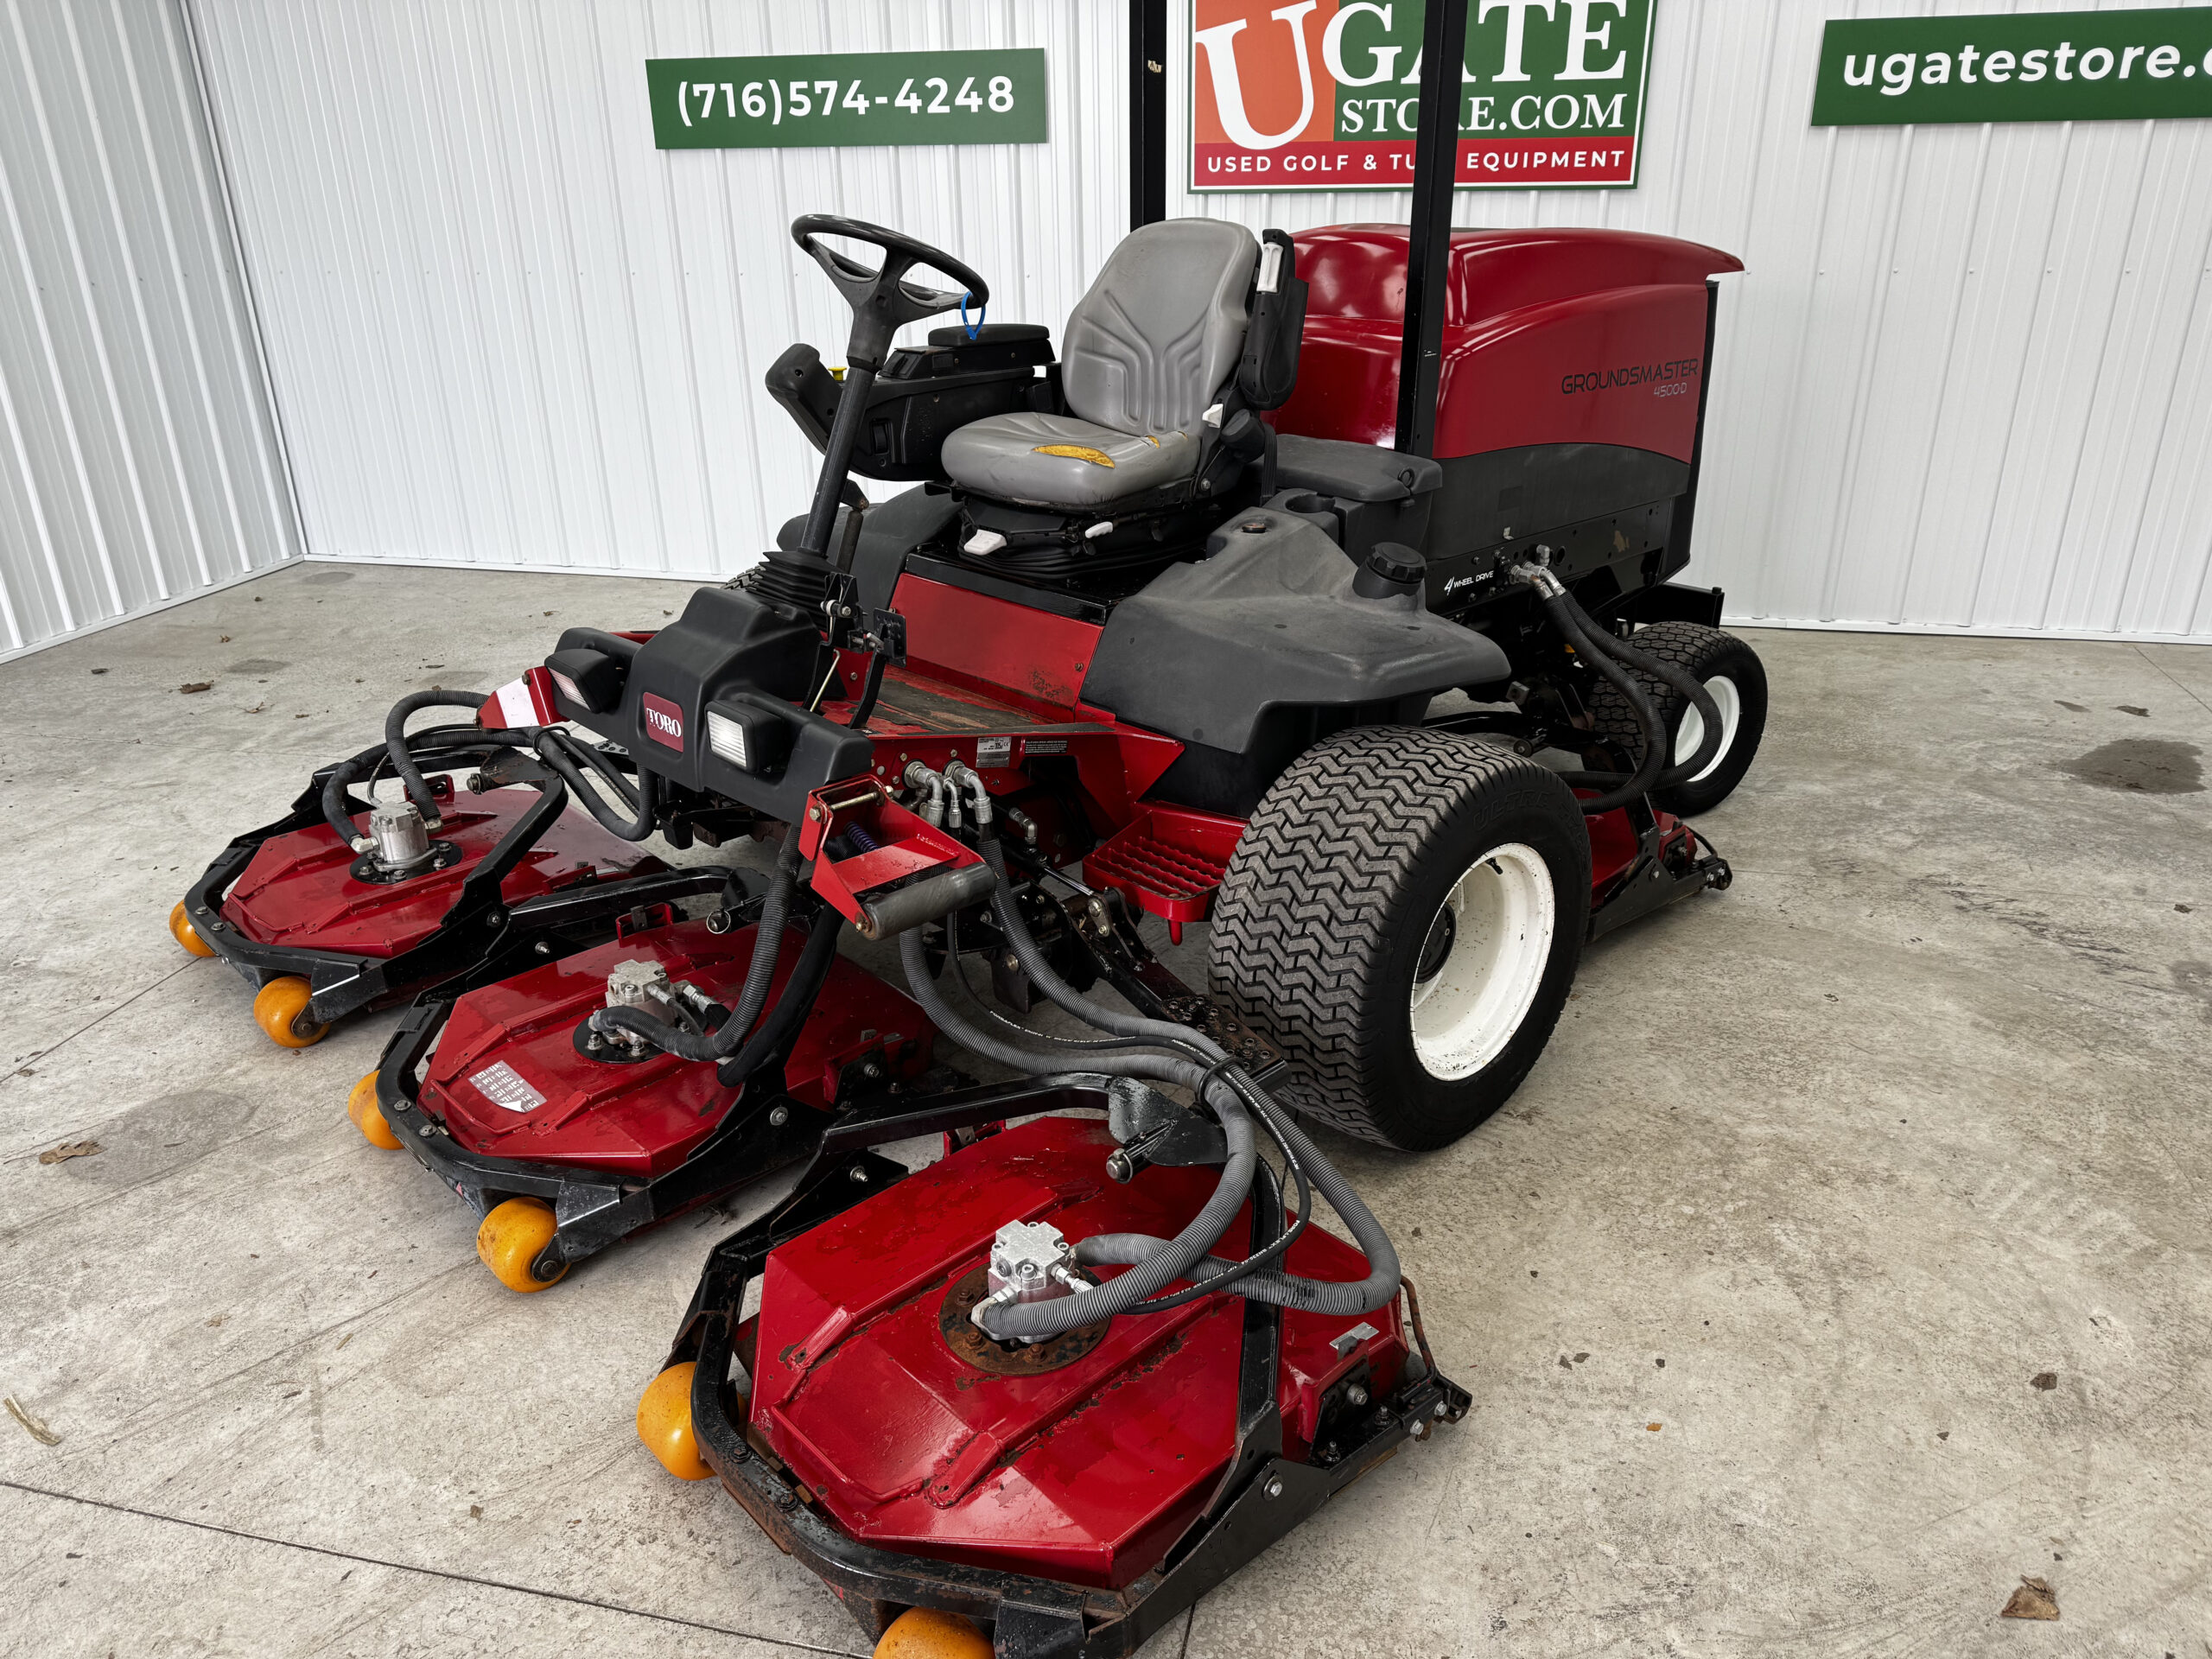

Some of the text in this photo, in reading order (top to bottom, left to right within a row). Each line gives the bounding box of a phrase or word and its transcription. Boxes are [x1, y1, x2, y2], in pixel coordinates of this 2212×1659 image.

[677, 75, 1015, 127] (716)574-4248
[1341, 93, 1628, 133] STOE.COM
[1207, 155, 1272, 173] USED
[1282, 154, 1350, 172] GOLF
[1363, 153, 1378, 171] &
[1466, 149, 1625, 172] EQUIPMENT
[1561, 358, 1699, 395] GROUNDSMASTER
[1444, 570, 1494, 596] 4 WHEEL DRIVE
[645, 707, 682, 738] TORO
